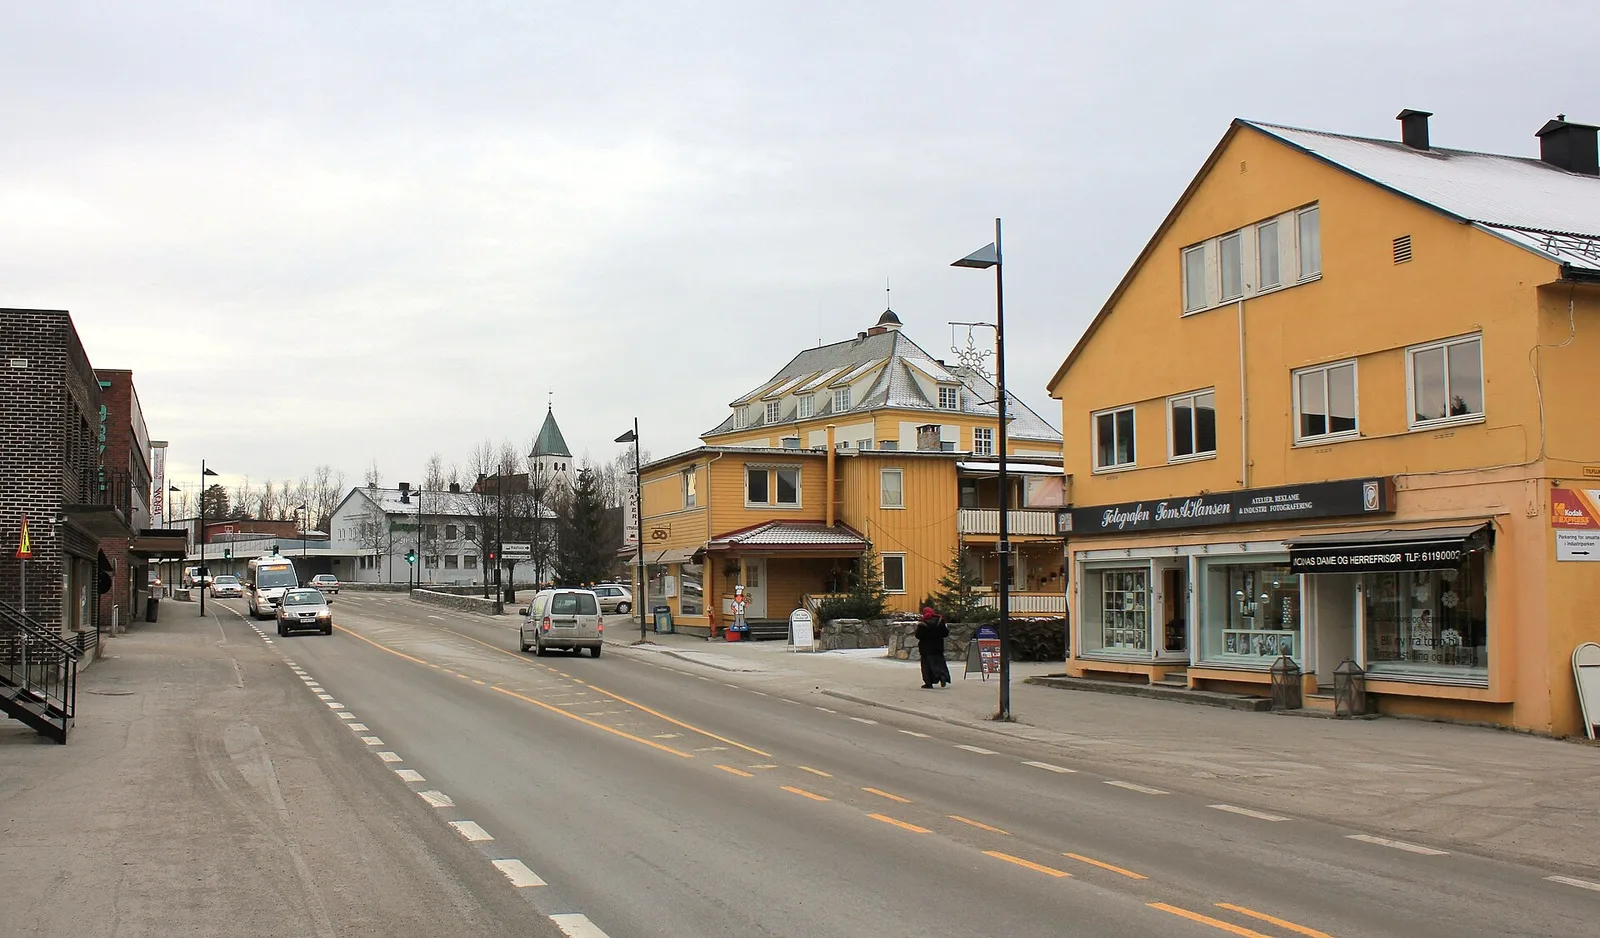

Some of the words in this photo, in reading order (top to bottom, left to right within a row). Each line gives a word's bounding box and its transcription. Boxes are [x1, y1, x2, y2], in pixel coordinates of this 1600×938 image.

[1274, 494, 1300, 503] REKLAME
[1244, 506, 1267, 514] INDUSTRI
[1270, 502, 1313, 512] FOTOGRAFERING
[1564, 509, 1583, 517] Kodak
[1101, 504, 1149, 530] Fotografen
[1316, 556, 1337, 566] DAME
[1338, 556, 1349, 564] OG
[1350, 553, 1403, 564] HERREFRISØR
[1405, 552, 1420, 561] TLF:
